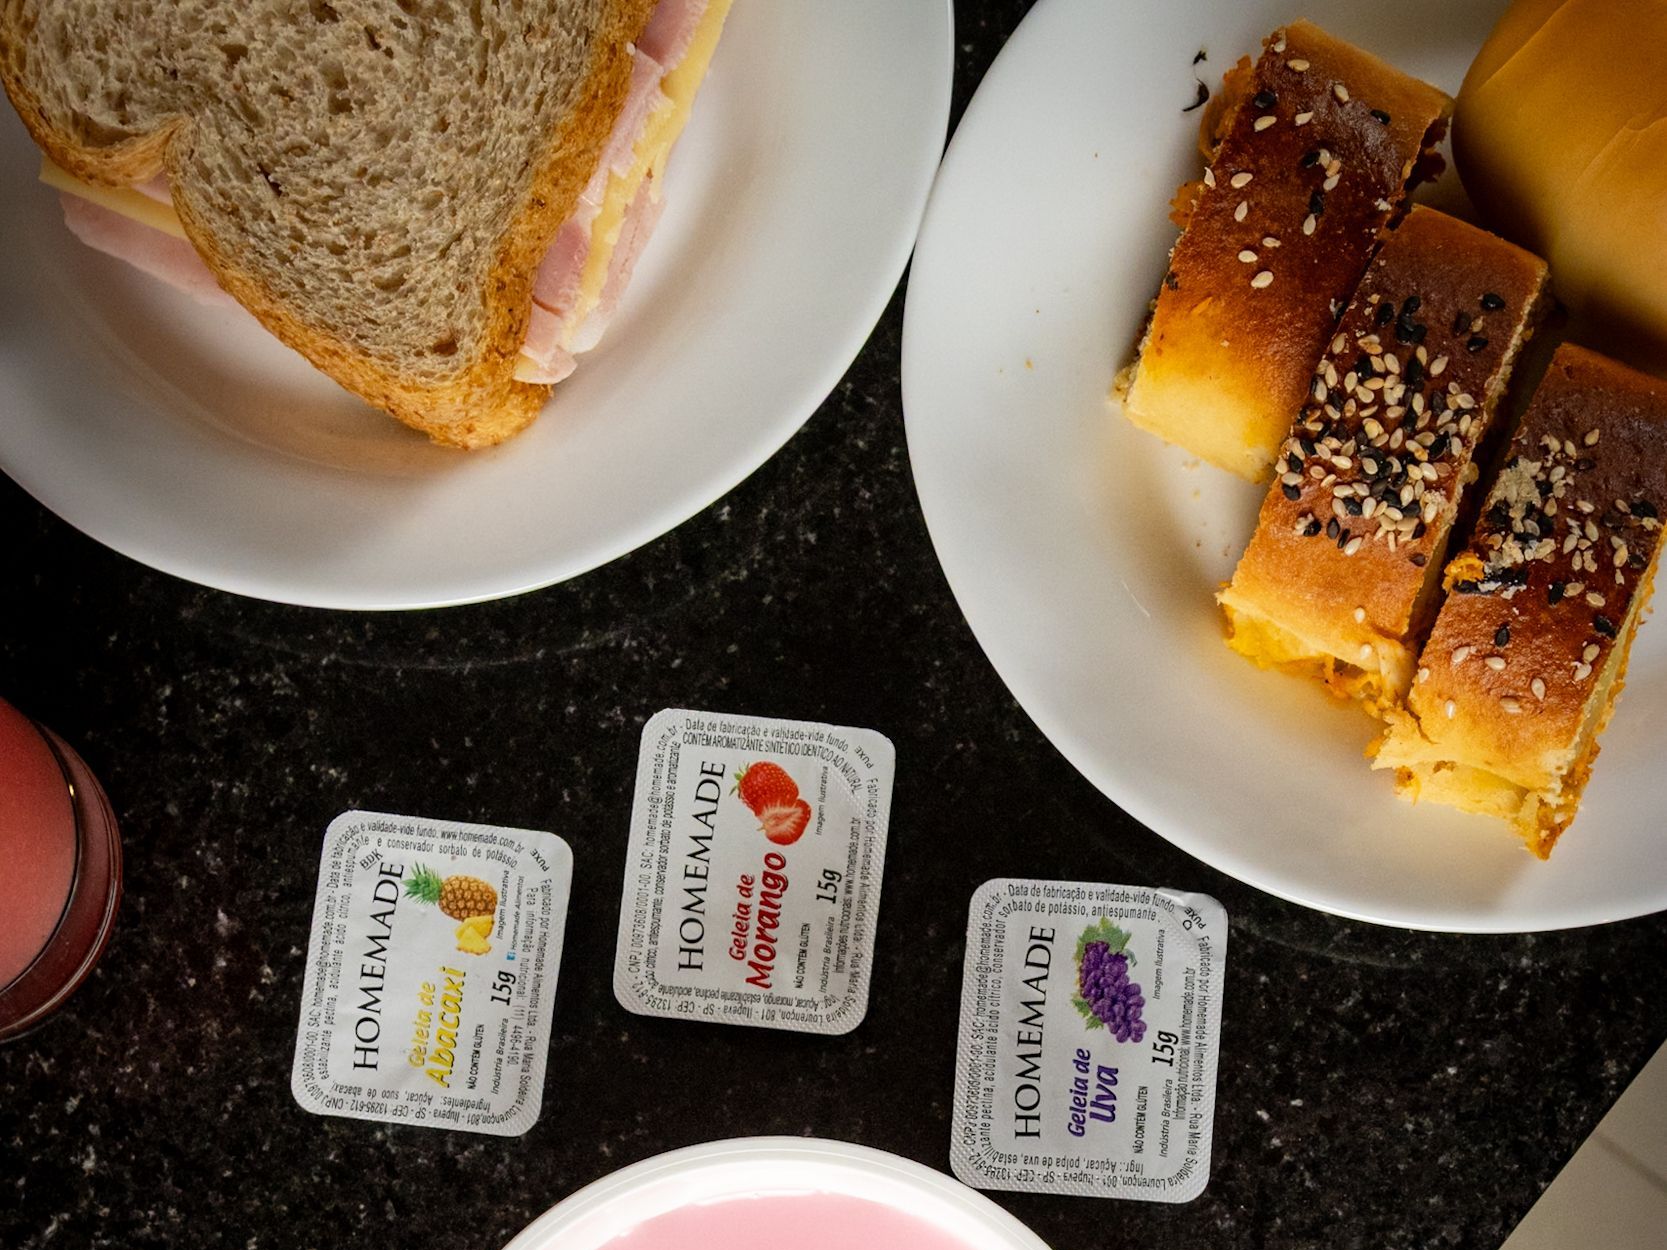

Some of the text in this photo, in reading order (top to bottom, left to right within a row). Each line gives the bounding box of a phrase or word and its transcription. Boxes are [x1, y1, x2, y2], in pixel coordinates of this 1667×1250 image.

[707, 720, 717, 732] de
[719, 721, 761, 737] fabricação
[854, 746, 874, 769] PUXE
[816, 805, 826, 836] Imagem
[359, 848, 384, 870] BDK
[530, 848, 549, 872] PUXE
[678, 761, 726, 972] HOMEMADE
[815, 869, 843, 904] 15g
[1007, 884, 1028, 897] Data
[1030, 884, 1041, 897] de
[1043, 885, 1086, 902] fabricação
[1088, 890, 1093, 900] e
[1095, 890, 1150, 905] validade-vide
[496, 908, 506, 940] Imagem
[728, 874, 755, 961] Geleia de
[745, 852, 789, 989] Morango
[998, 899, 1033, 918] sorbato
[1035, 900, 1045, 913] de
[1048, 901, 1089, 918] potássio,
[1184, 906, 1207, 930] PUXE
[819, 916, 835, 993] Indústria Brasileira
[991, 919, 1006, 974] conservador
[1152, 929, 1165, 1000] Imagem Ilustrativa
[1198, 935, 1213, 978] Fabricado
[353, 861, 405, 1071] HOMEMADE
[367, 1088, 376, 1098] de
[387, 839, 434, 853] conservador
[438, 843, 467, 856] sorbato
[472, 846, 481, 858] de
[490, 970, 516, 1006] 15g
[407, 981, 436, 1069] Geleia de
[424, 966, 466, 1089] Abacaxi
[986, 1009, 1000, 1033] ácido
[1014, 926, 1056, 1140] HOMEMADE
[491, 1018, 508, 1095] Indústria Brasileira
[982, 1036, 998, 1082] acidulante
[1151, 1030, 1179, 1067] 15g
[1067, 1048, 1091, 1138] Geleia de
[1089, 1065, 1119, 1123] Uva
[1132, 1085, 1148, 1154] NÃO CONTÉM GLÚTEN
[1159, 1079, 1173, 1158] Indústria Brasileira
[1189, 1113, 1202, 1129] Rua
[1042, 1156, 1053, 1167] de
[1055, 1156, 1080, 1169] polpa
[1084, 1158, 1117, 1173] Açúcar,
